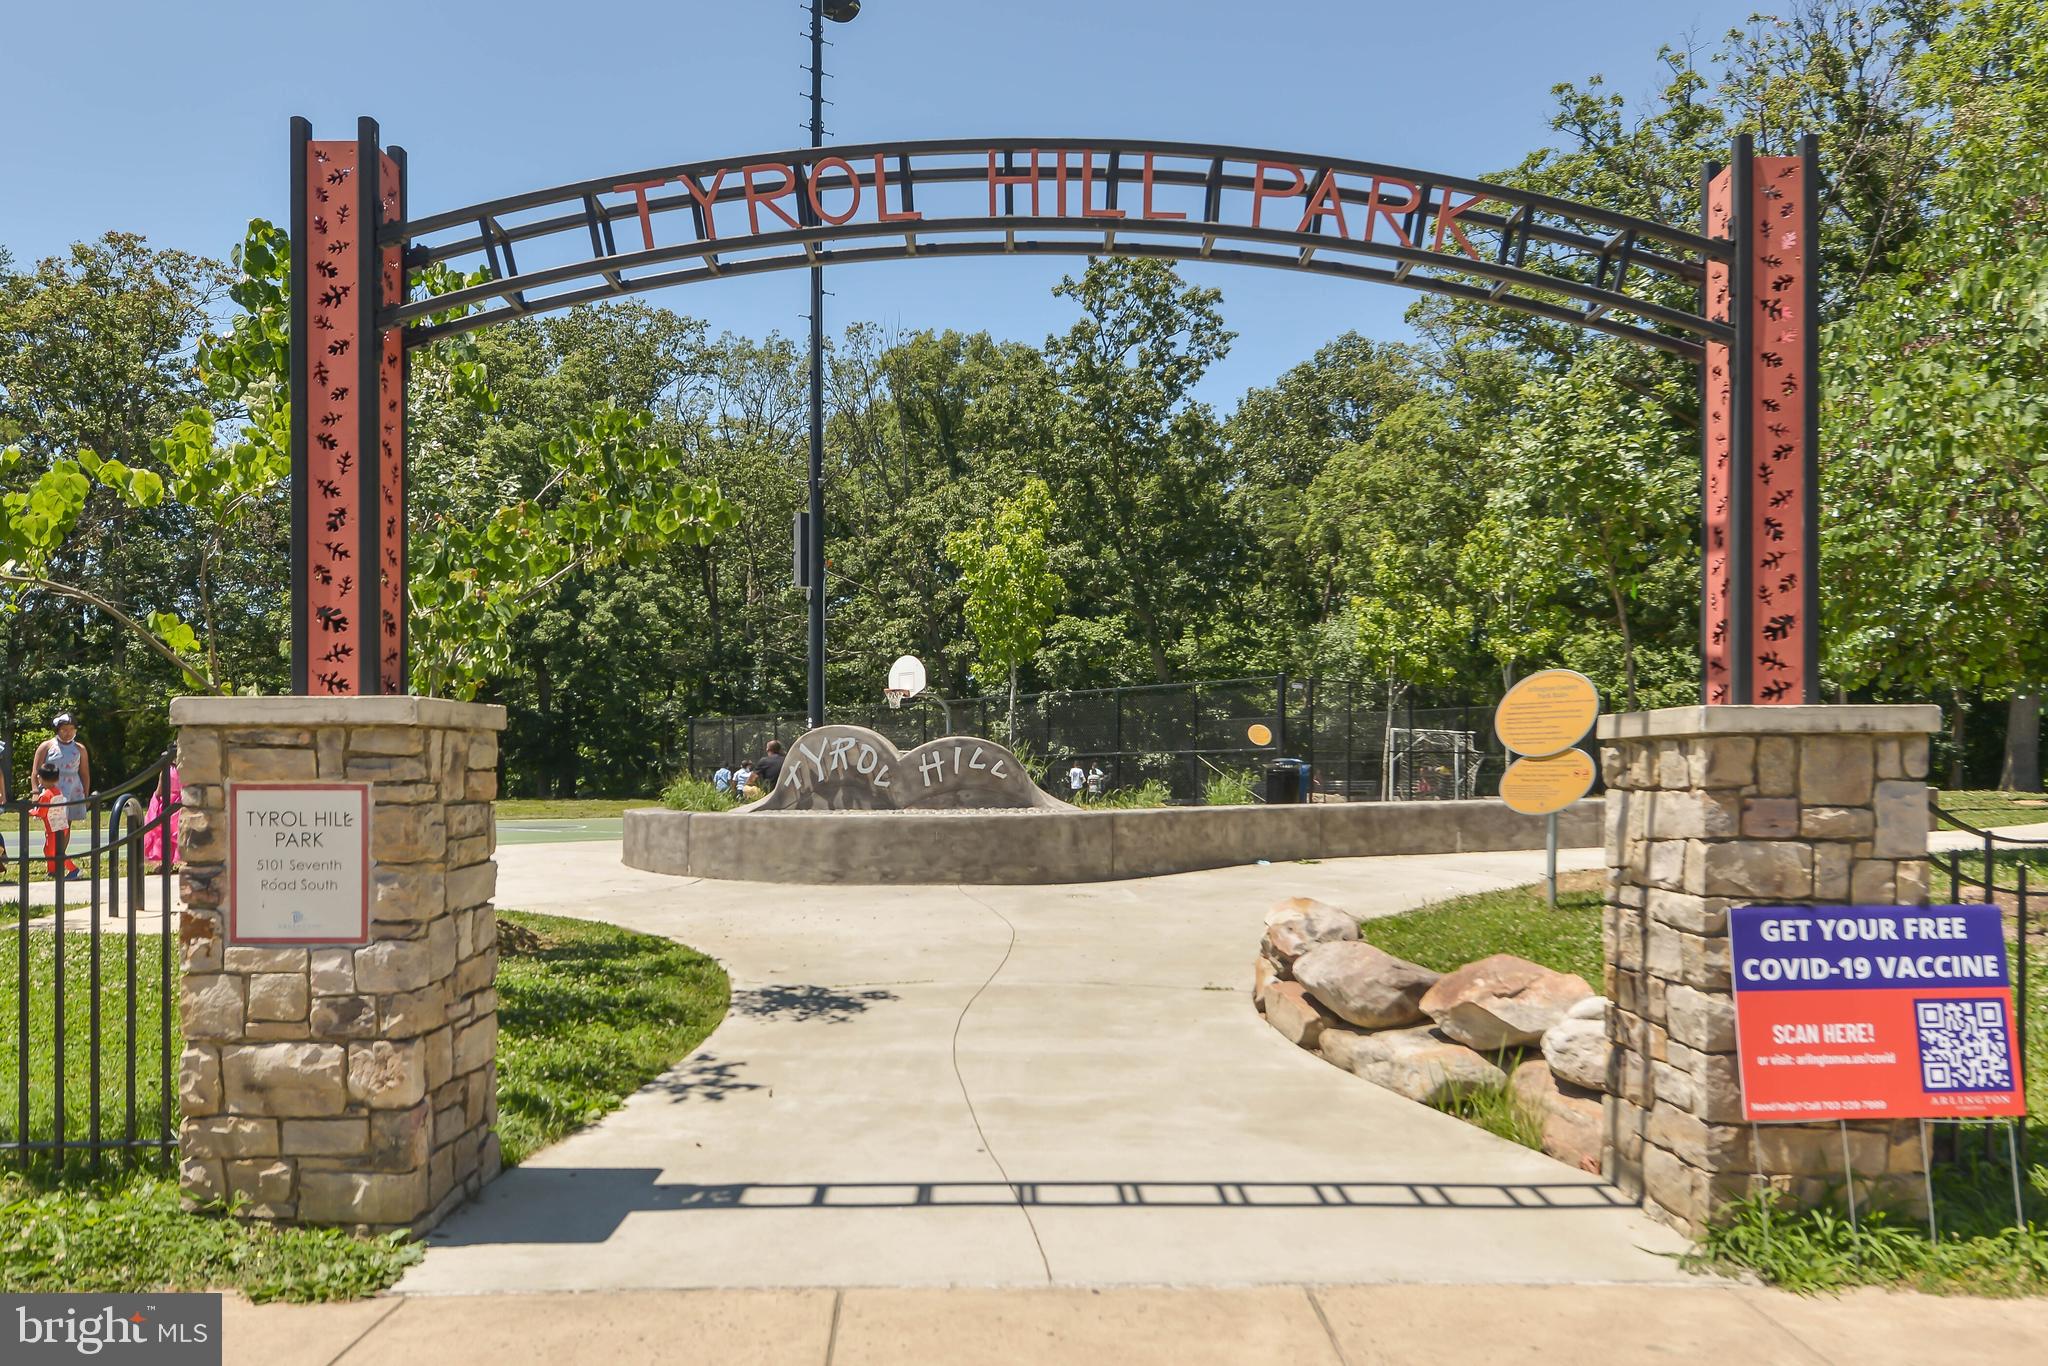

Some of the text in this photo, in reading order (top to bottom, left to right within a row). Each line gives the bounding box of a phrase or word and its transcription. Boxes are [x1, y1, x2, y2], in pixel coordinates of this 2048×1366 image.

[613, 148, 1487, 261] TYROL HILL PARK
[784, 737, 1008, 790] TYROL HILL
[246, 811, 353, 828] TYROL HILL
[275, 832, 324, 848] PARK
[256, 859, 342, 872] 5101 Seventh
[261, 878, 338, 891] Road South
[1760, 917, 1968, 942] GET YOUR FREE
[1742, 955, 2000, 981] COVID-19 VACCINE
[1772, 1022, 1876, 1044] SCAN HERE!
[1930, 1094, 2011, 1105] ARLINGTON
